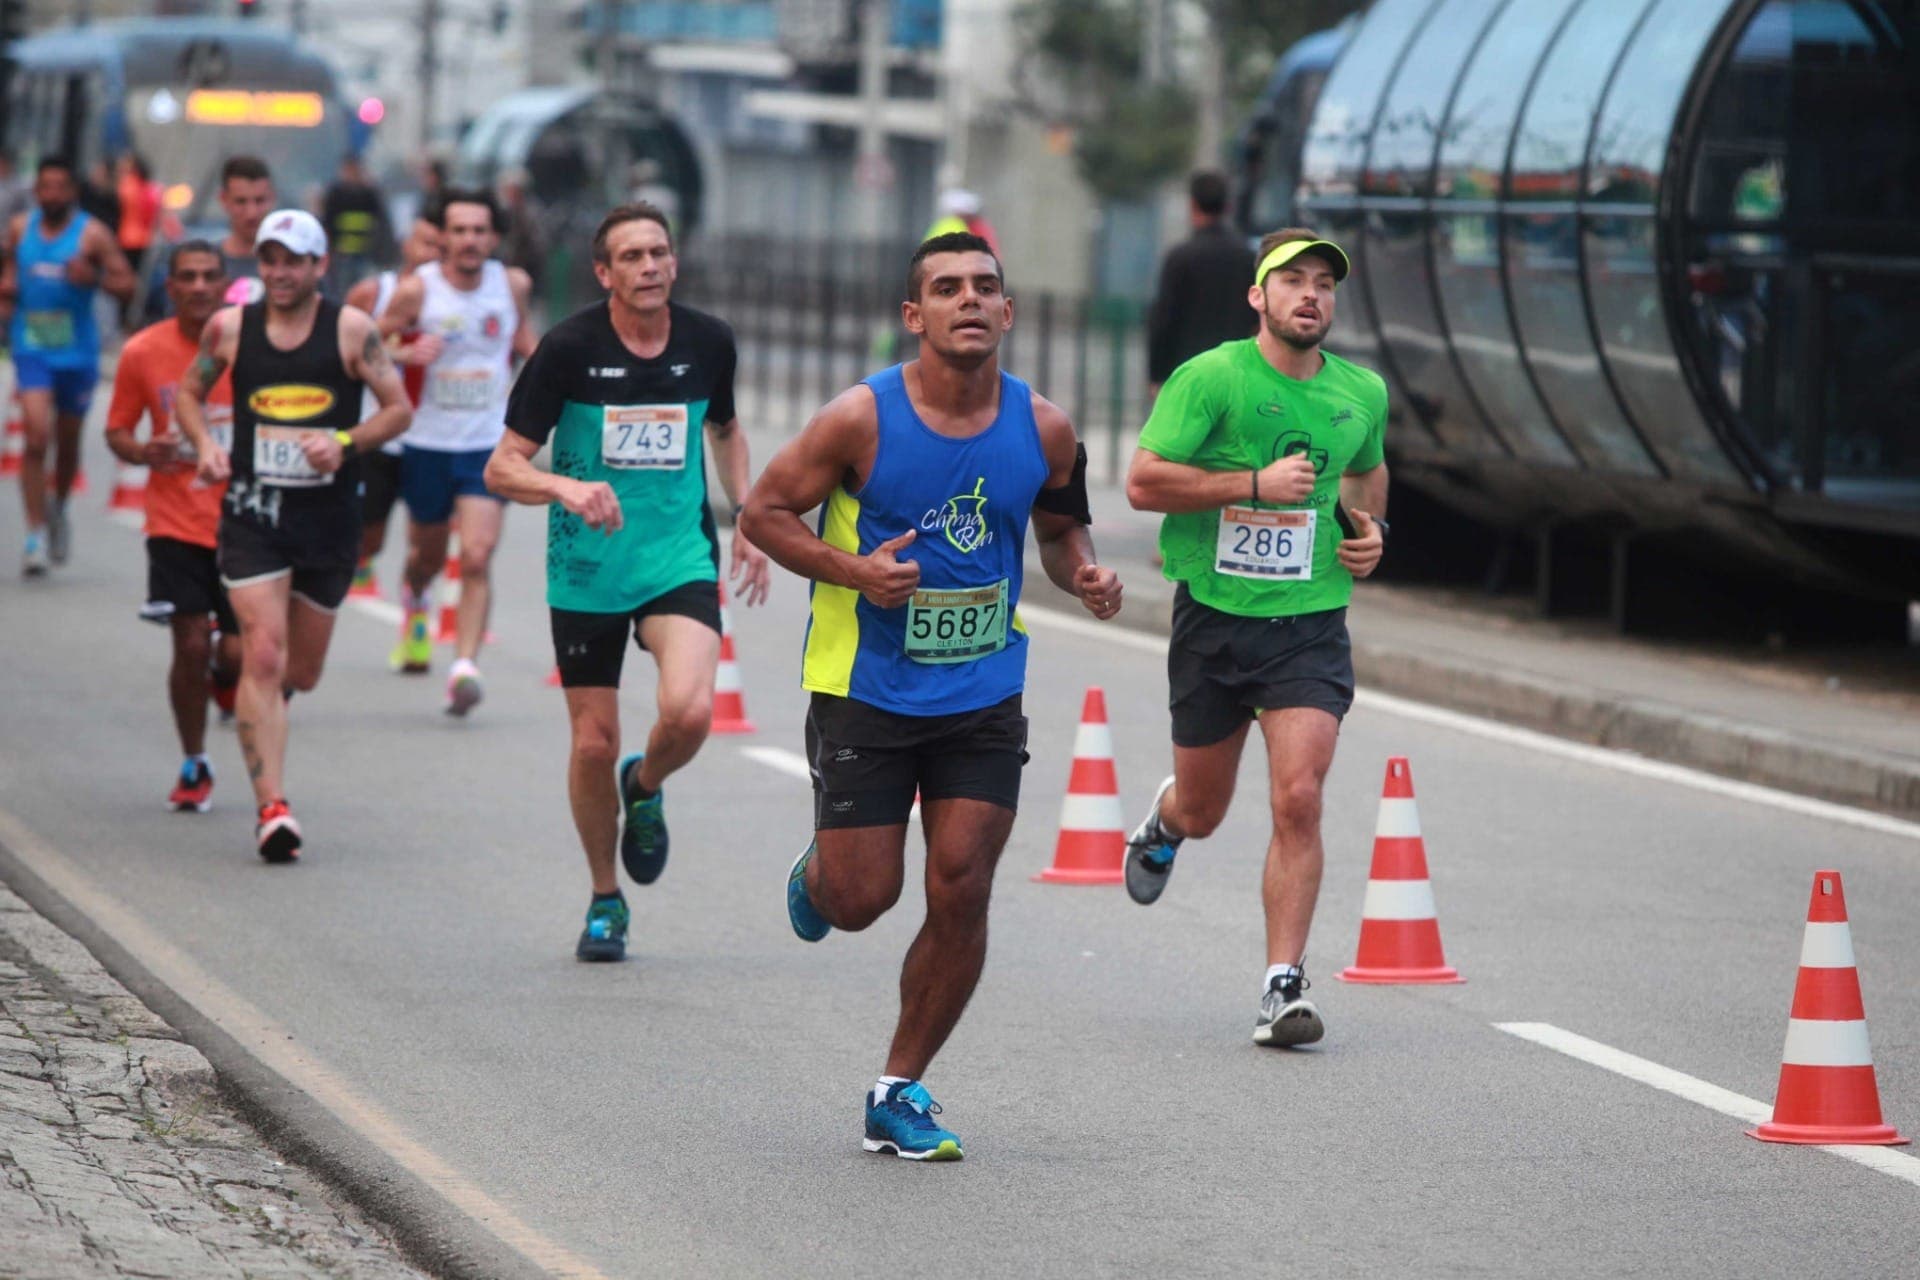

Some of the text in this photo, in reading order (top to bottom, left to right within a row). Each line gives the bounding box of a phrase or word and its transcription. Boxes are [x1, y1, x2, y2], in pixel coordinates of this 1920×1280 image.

[617, 423, 673, 451] 743
[1232, 525, 1294, 558] 286
[911, 602, 999, 640] 5687
